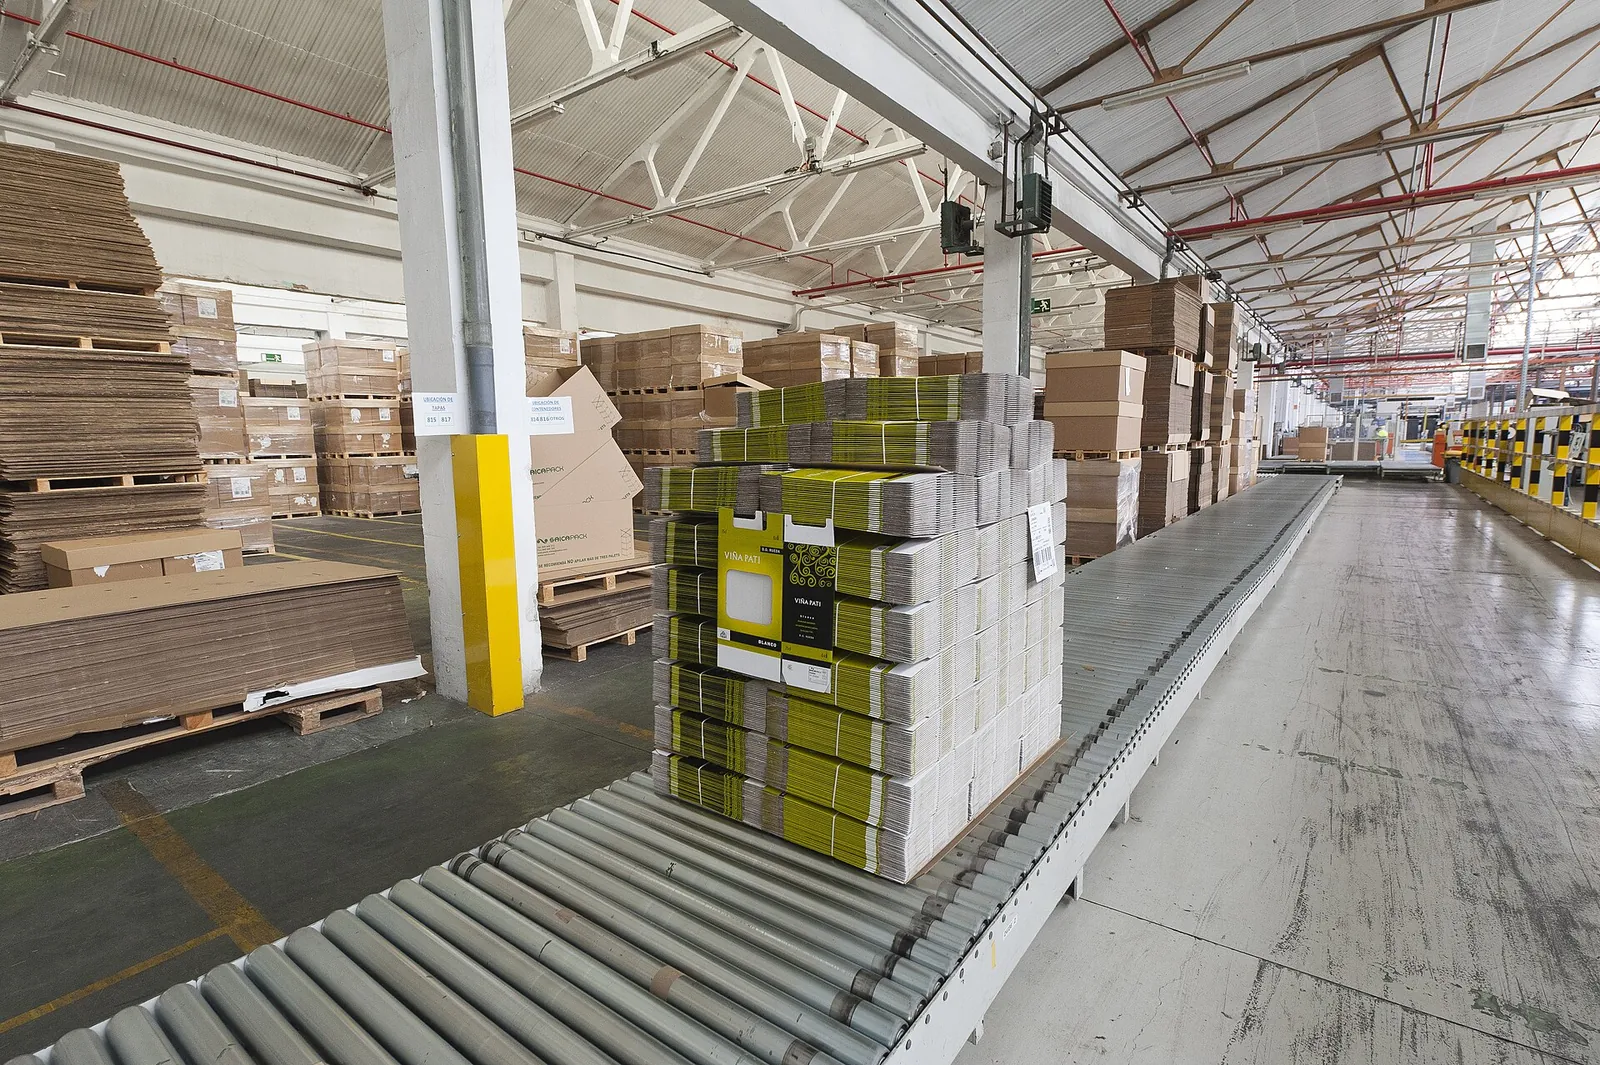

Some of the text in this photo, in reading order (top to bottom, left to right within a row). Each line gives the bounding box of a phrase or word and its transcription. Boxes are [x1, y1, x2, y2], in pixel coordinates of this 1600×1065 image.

[530, 466, 564, 475] AICAPACK
[549, 533, 588, 543] SAICAPACK
[724, 551, 761, 564] VIÑA PATI
[794, 597, 822, 607] VIÑA PATI
[758, 640, 777, 648] BLANCO
